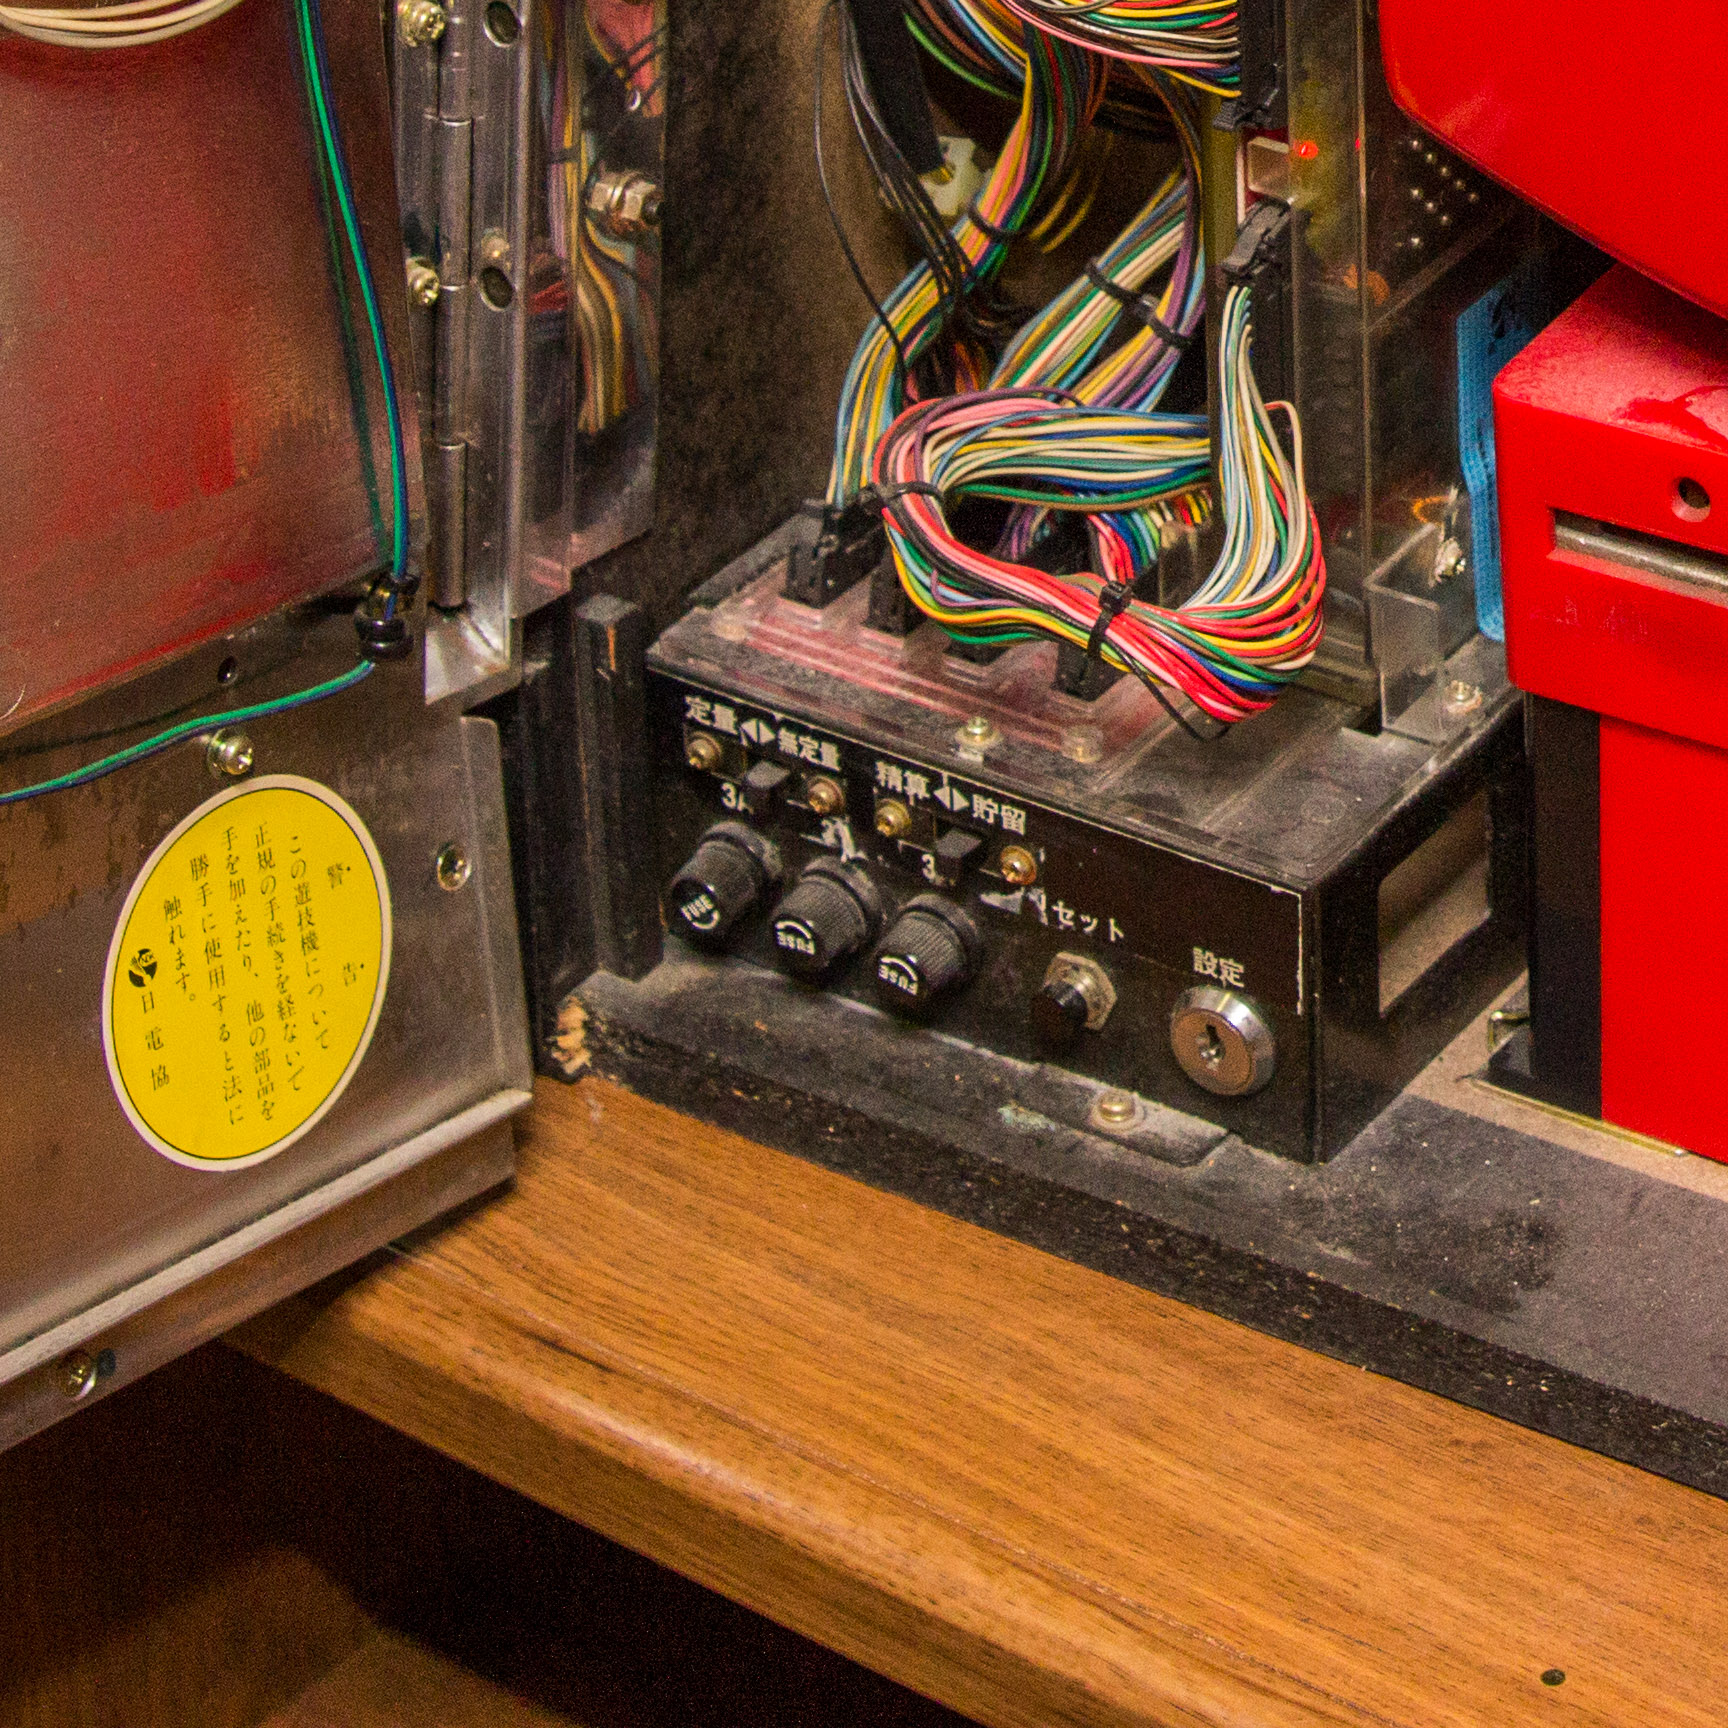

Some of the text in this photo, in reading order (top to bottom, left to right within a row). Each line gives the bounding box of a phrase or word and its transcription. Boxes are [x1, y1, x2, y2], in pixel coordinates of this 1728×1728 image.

[681, 894, 715, 922] FUSE
[776, 930, 817, 956] FUSE
[878, 964, 919, 997] FUSE
[1192, 945, 1245, 989] 設定
